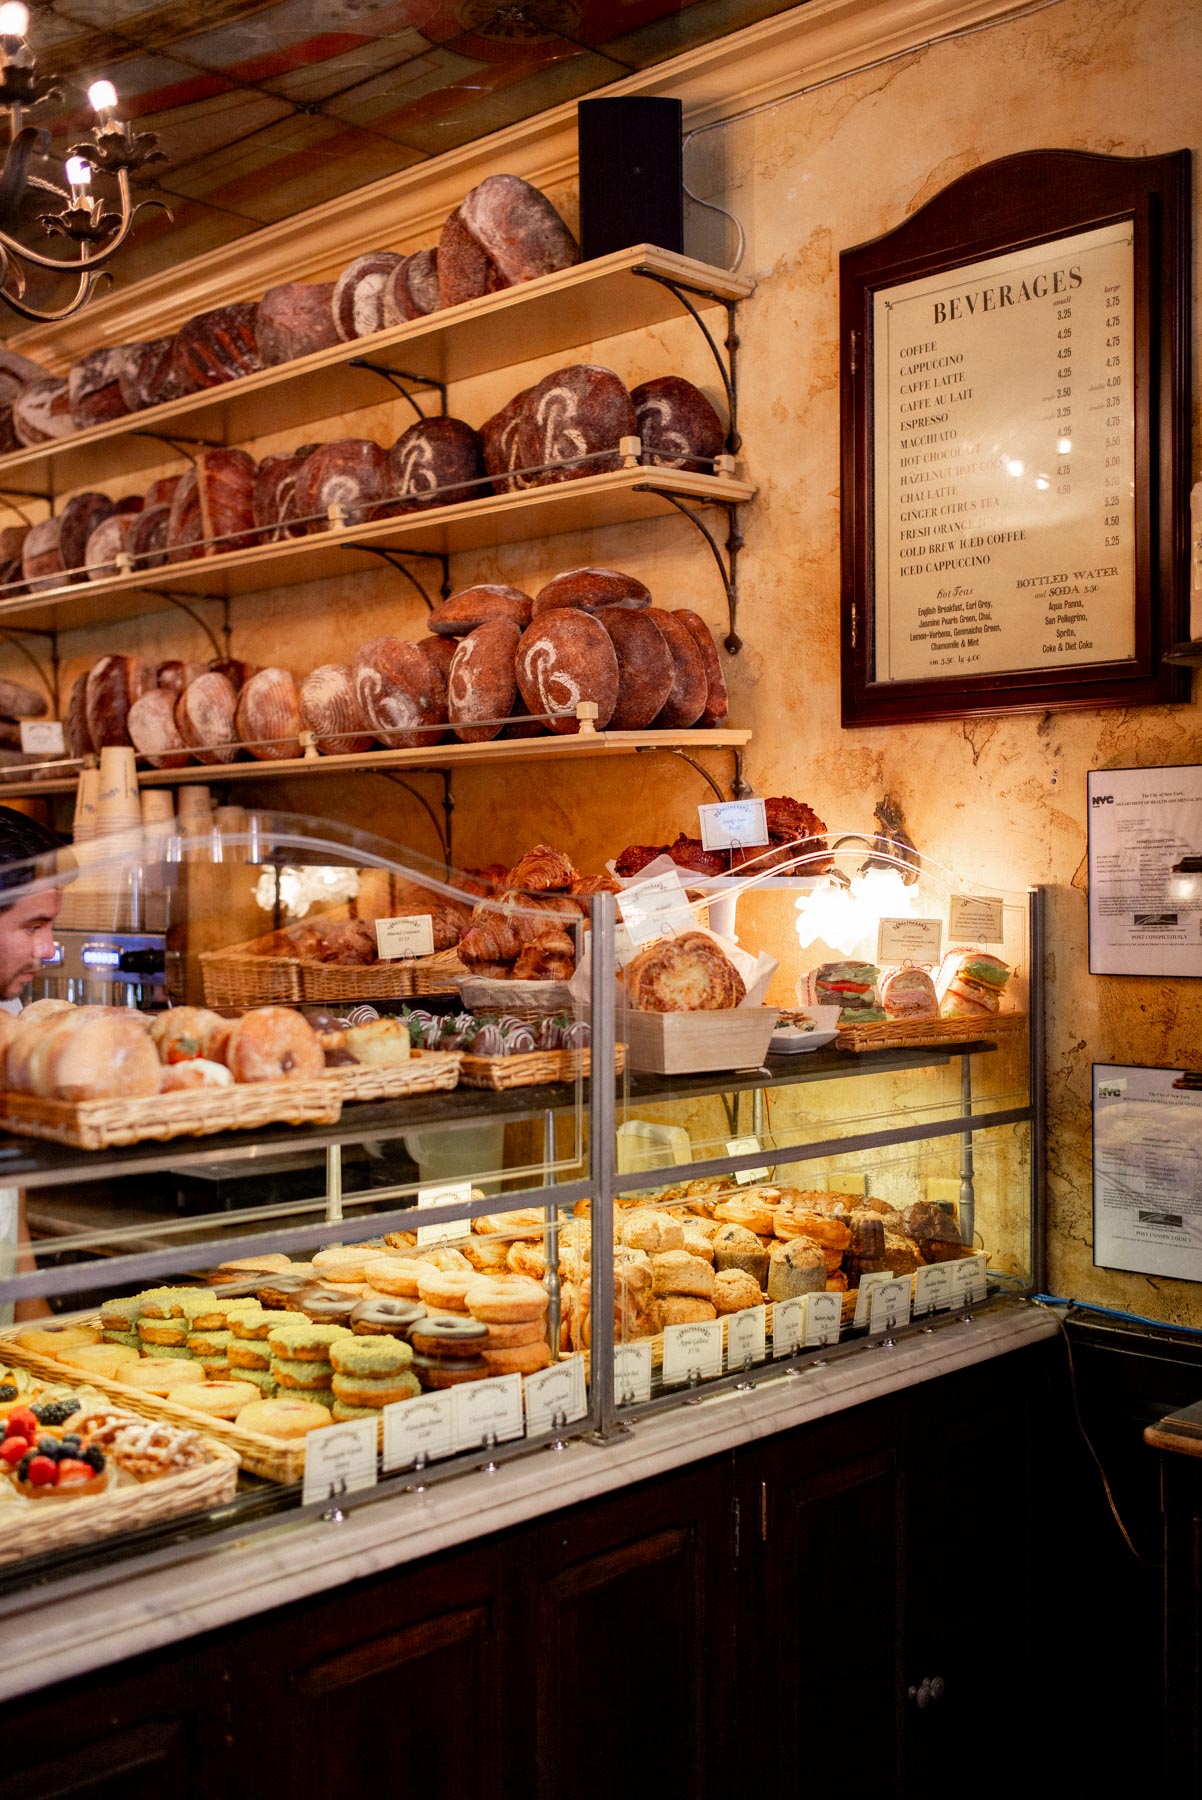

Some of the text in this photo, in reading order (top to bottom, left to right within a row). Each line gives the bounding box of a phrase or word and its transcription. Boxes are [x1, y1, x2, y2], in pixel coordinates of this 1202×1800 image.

[933, 265, 1083, 325] BEVERAGES
[1106, 296, 1120, 308] 3.75
[1058, 308, 1072, 320] 3.25
[1106, 316, 1120, 328] 4.75
[1058, 328, 1072, 340] 4.25
[1106, 336, 1120, 348] 4.75
[900, 341, 937, 358] COFFEE
[1058, 348, 1072, 359] 4.25
[900, 353, 964, 376] CAPPUCCINO
[1106, 356, 1120, 368] 4.75
[1058, 367, 1072, 378] 4.25
[900, 372, 966, 395] CAFFE LATTE
[1106, 376, 1121, 388] 4.00
[1057, 387, 1071, 398] 3.50
[900, 388, 973, 413] CAFFE AU LAIT
[1106, 396, 1120, 408] 3.75
[1057, 406, 1071, 418] 3.25
[900, 412, 948, 431] ESPRESSO
[900, 430, 957, 448] MACCHIATO
[900, 456, 920, 468] HOT
[1057, 465, 1070, 476] 4.75
[900, 468, 954, 486] HAZELNUT
[900, 486, 959, 504] CHAI LATTE
[1105, 496, 1119, 507] 5.25
[900, 497, 1000, 522] GINGER CITRUS TEA
[1104, 516, 1119, 527] 4.50
[900, 526, 930, 540] FRESH
[934, 519, 974, 534] ORANGE
[900, 530, 1026, 558] COLD BREW ICED COFFEE
[1105, 536, 1119, 547] 5.25
[900, 554, 990, 576] ICED CAPPUCCINO
[1016, 566, 1119, 588] BOTTLED WATER
[952, 586, 974, 597] Teas
[1048, 585, 1080, 597] SODA
[918, 600, 992, 617] English Breakfast, Earl Grey,
[1049, 600, 1084, 611] Aqua Panna,
[919, 619, 940, 628] Jasmine
[942, 616, 958, 625] Pearls
[960, 615, 977, 624] Green,
[1045, 613, 1088, 625] San Pellegrino,
[984, 624, 1001, 632] Green,
[1056, 628, 1076, 639] Sprite,
[931, 640, 959, 651] Chamomile
[968, 638, 979, 647] Mint
[1042, 640, 1093, 653] Coke & Diet Coke
[1092, 796, 1114, 805] NYC
[1099, 1088, 1120, 1097] NYC
